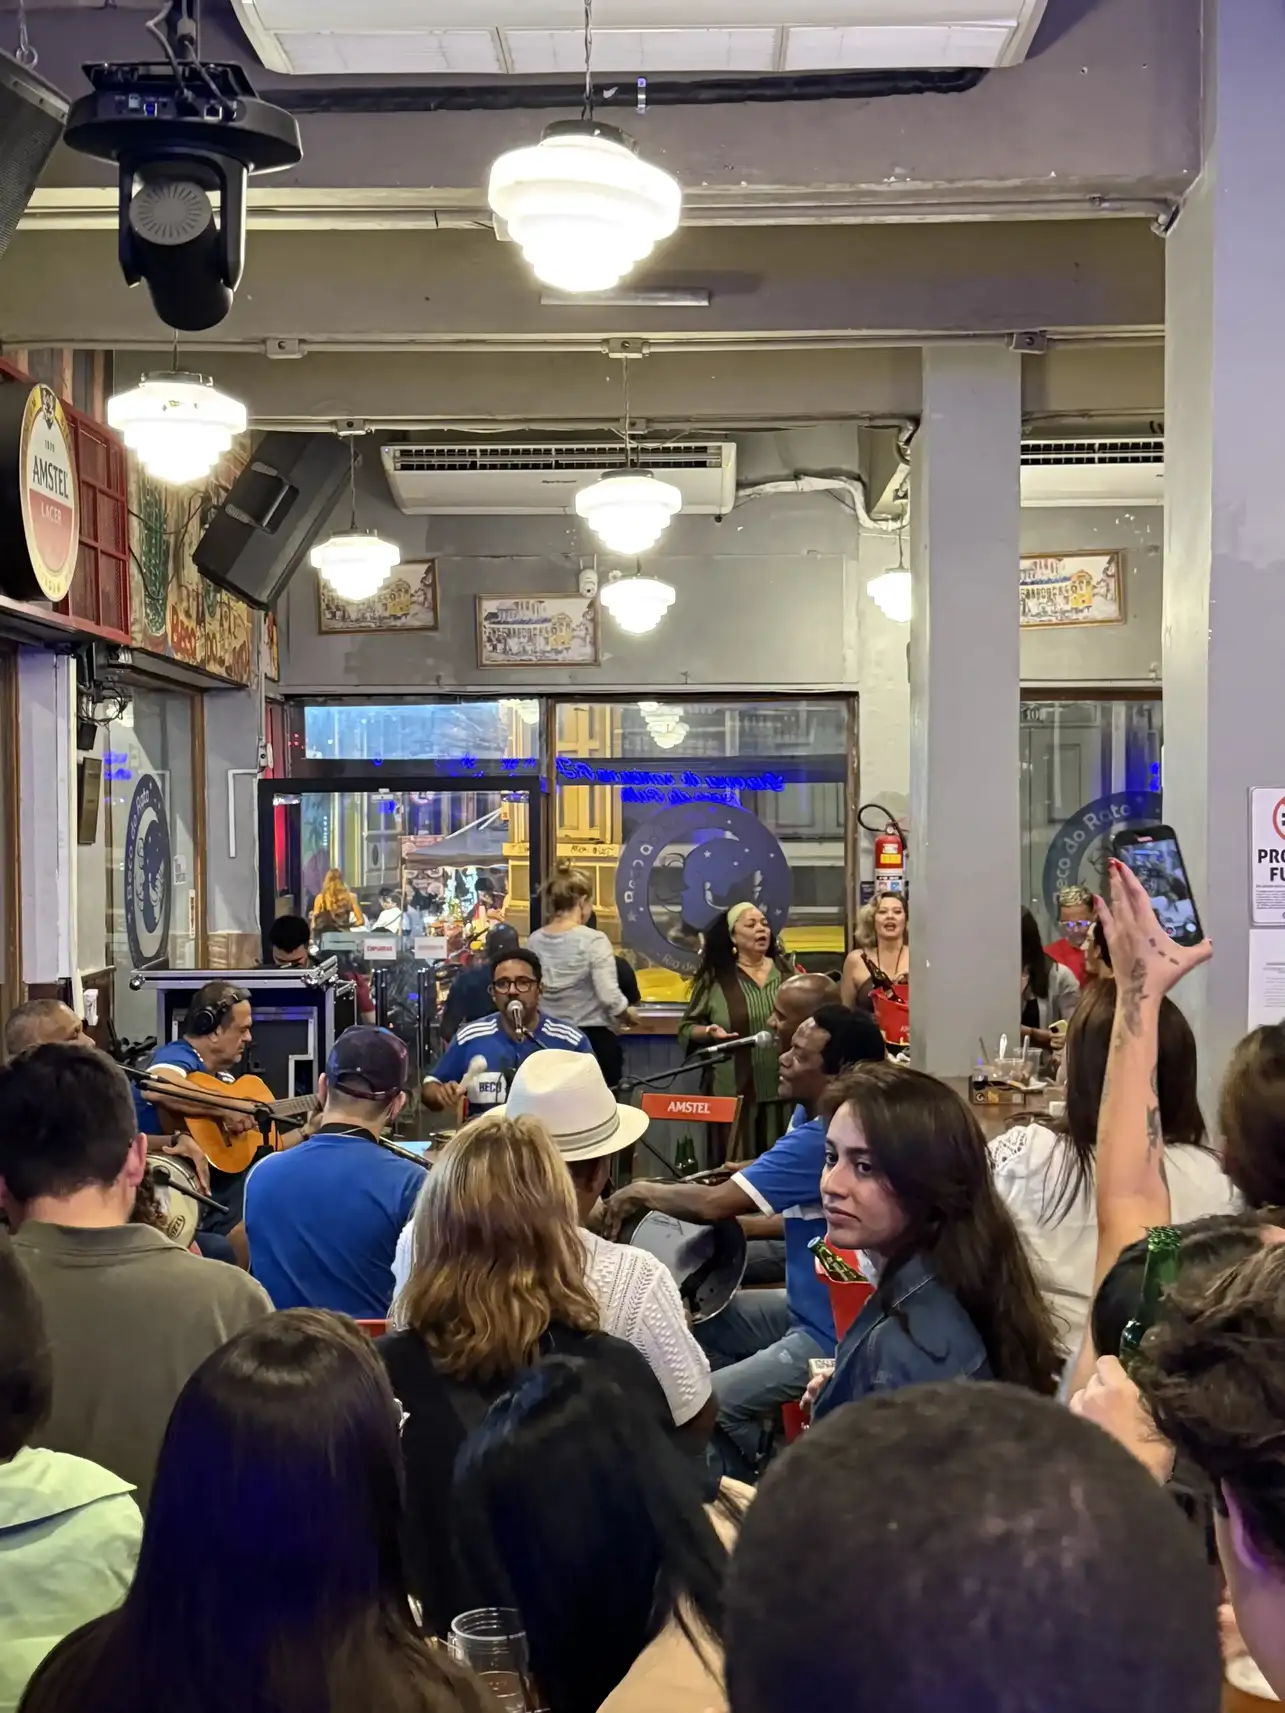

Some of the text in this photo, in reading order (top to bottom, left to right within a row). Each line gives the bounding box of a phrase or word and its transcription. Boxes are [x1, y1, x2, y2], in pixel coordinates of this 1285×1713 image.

[32, 455, 69, 499] AMSTEL
[41, 501, 62, 525] LAGER
[1063, 830, 1086, 855] do
[479, 1081, 502, 1093] BECO
[667, 1101, 711, 1114] AMSTEL
